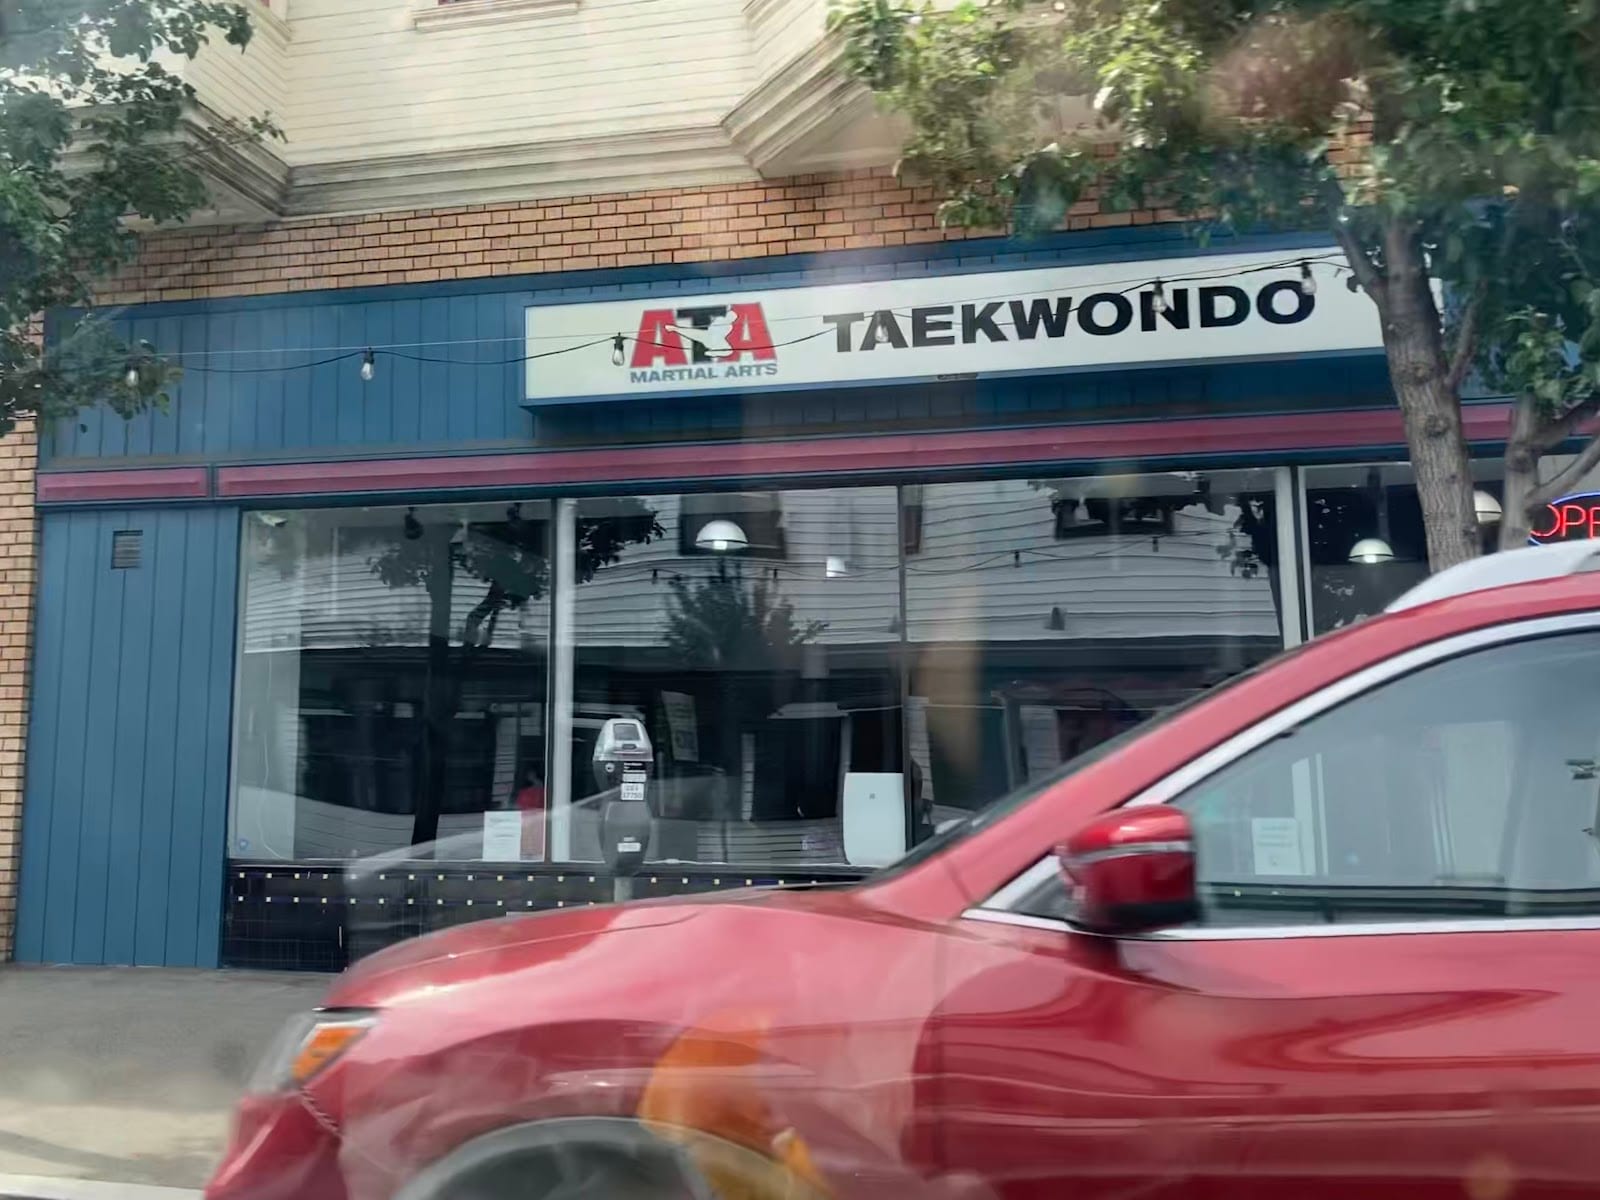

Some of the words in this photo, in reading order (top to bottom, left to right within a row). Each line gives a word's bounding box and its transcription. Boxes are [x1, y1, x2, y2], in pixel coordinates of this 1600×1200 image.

[630, 302, 777, 367] ATA
[823, 280, 1315, 353] TAEKWONDO
[630, 367, 718, 383] MARTIAL
[724, 363, 778, 377] ARTS
